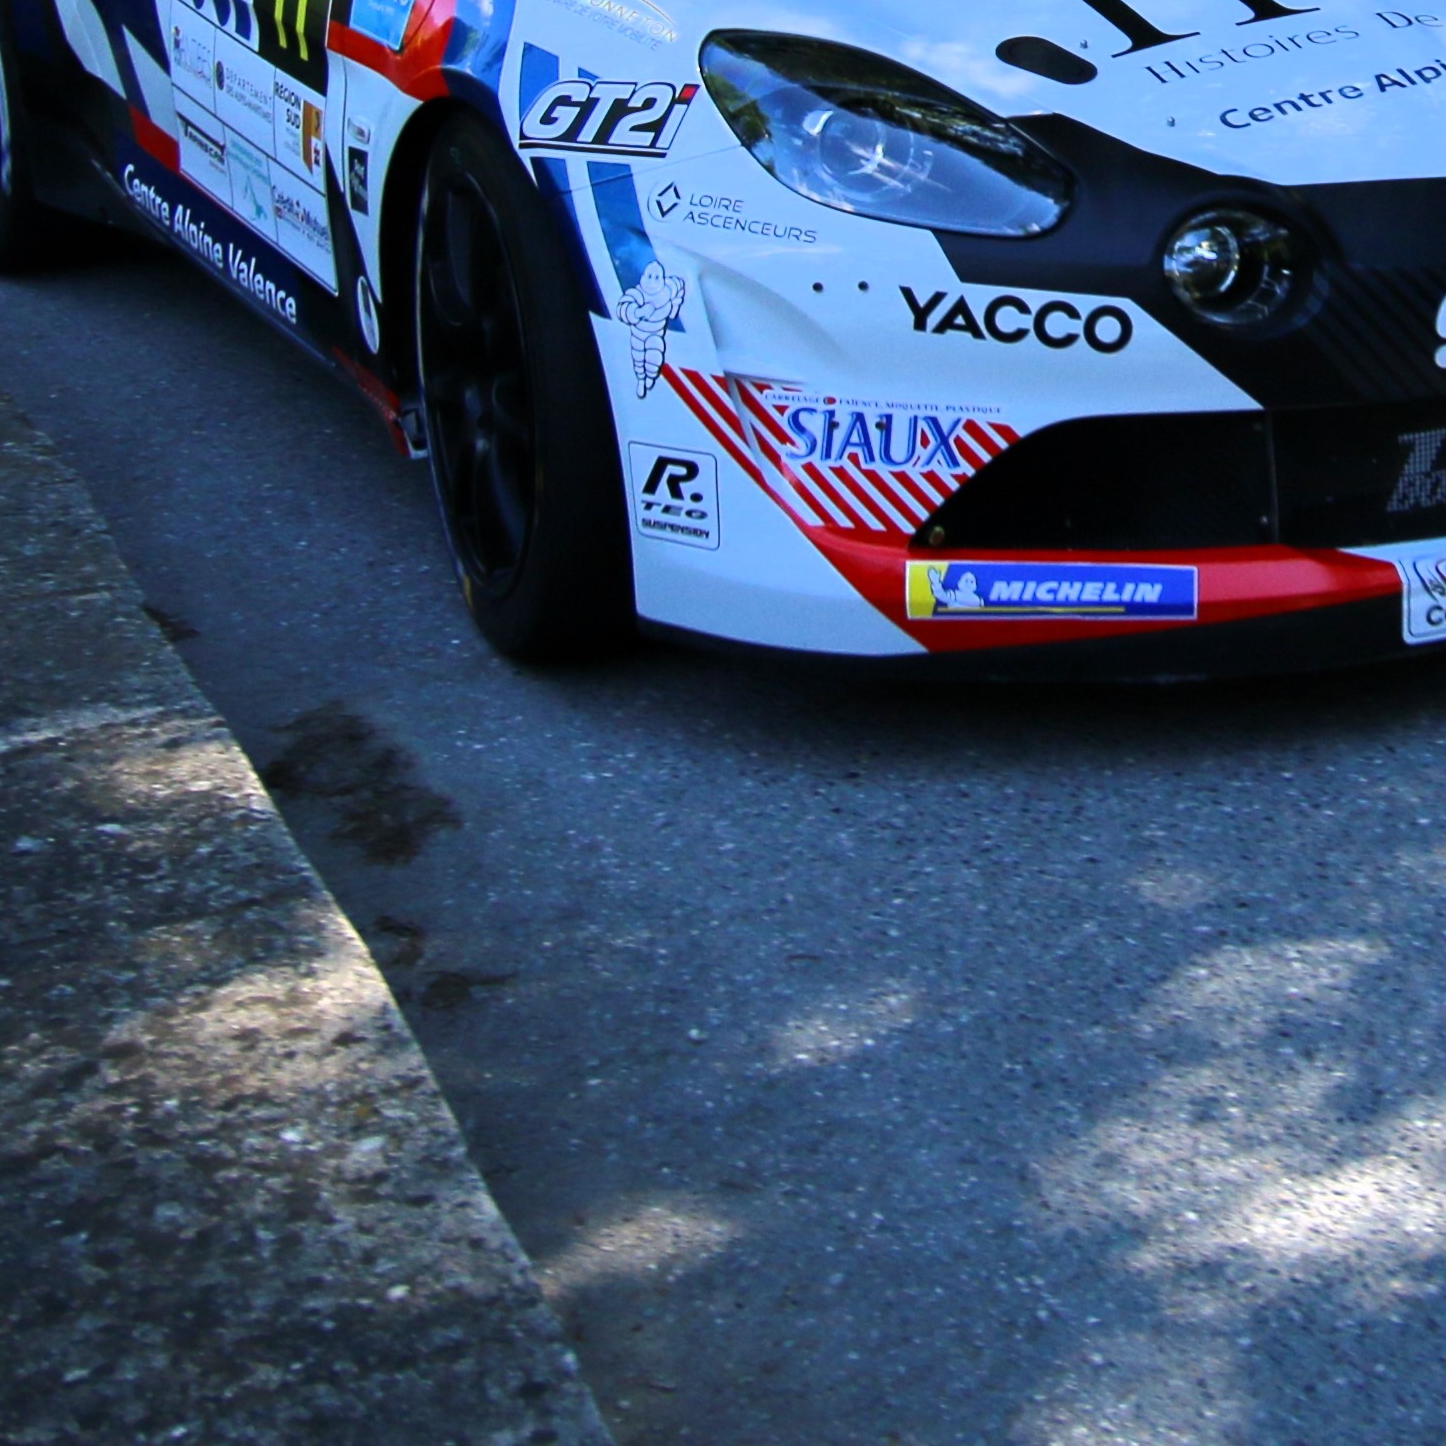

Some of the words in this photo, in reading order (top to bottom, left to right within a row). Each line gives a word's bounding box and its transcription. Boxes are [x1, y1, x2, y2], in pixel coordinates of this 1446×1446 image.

[1144, 24, 1360, 85] Histoires
[1374, 10, 1444, 30] De
[519, 79, 700, 152] GT2i
[1219, 83, 1365, 130] Centre
[688, 192, 744, 214] LOIRE
[123, 163, 171, 227] Centre
[173, 204, 223, 269] Alpine
[228, 242, 297, 325] Valence
[681, 210, 818, 244] ASCENCEURS
[898, 285, 1133, 354] YACCO
[641, 517, 710, 539] SUSPENSION
[988, 579, 1163, 604] MICHELIN
